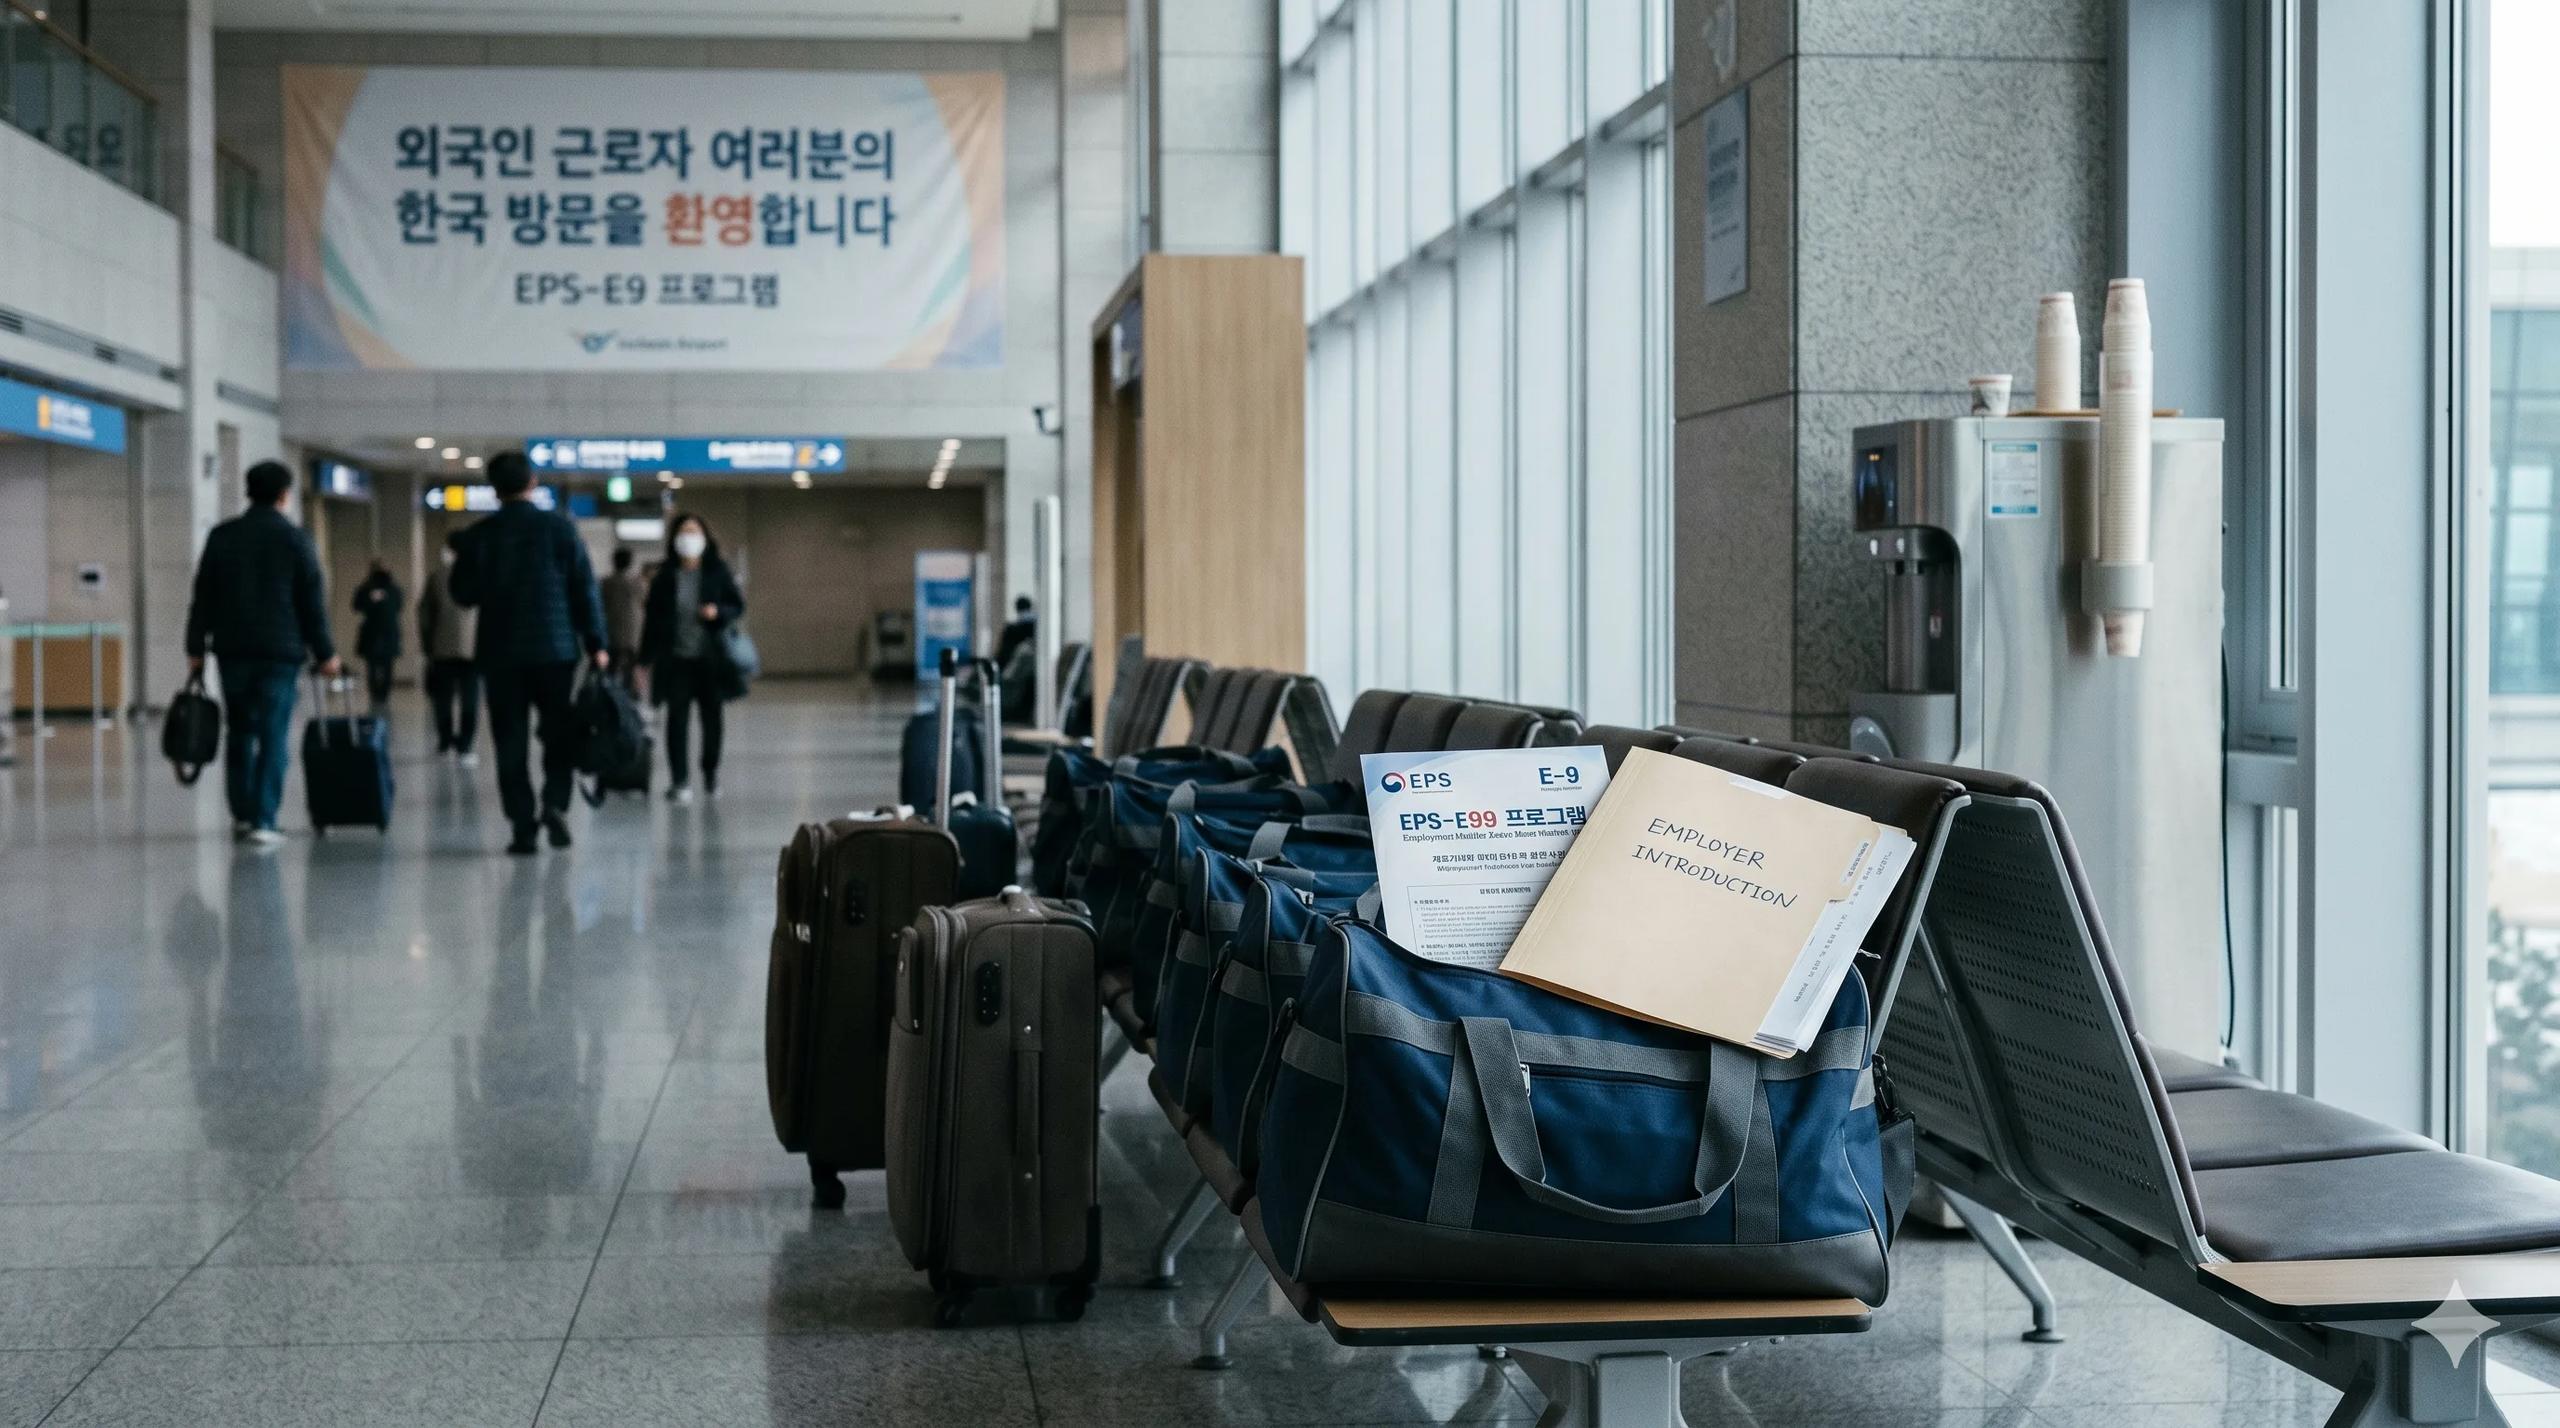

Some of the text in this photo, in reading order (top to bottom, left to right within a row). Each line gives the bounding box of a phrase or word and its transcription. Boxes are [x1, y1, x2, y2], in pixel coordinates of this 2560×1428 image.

[396, 124, 894, 181] 외국인 근로자 여러분의
[396, 190, 896, 247] 한국 방문을 환영합니다
[514, 273, 778, 309] EPS-E9 프로그램
[1410, 772, 1452, 788] EPS
[1538, 766, 1580, 785] E-9
[1399, 805, 1587, 831] EPS-E99 프로그램
[1647, 818, 1765, 870] EMPLOYER
[1631, 844, 1798, 908] INTRODUCTION
